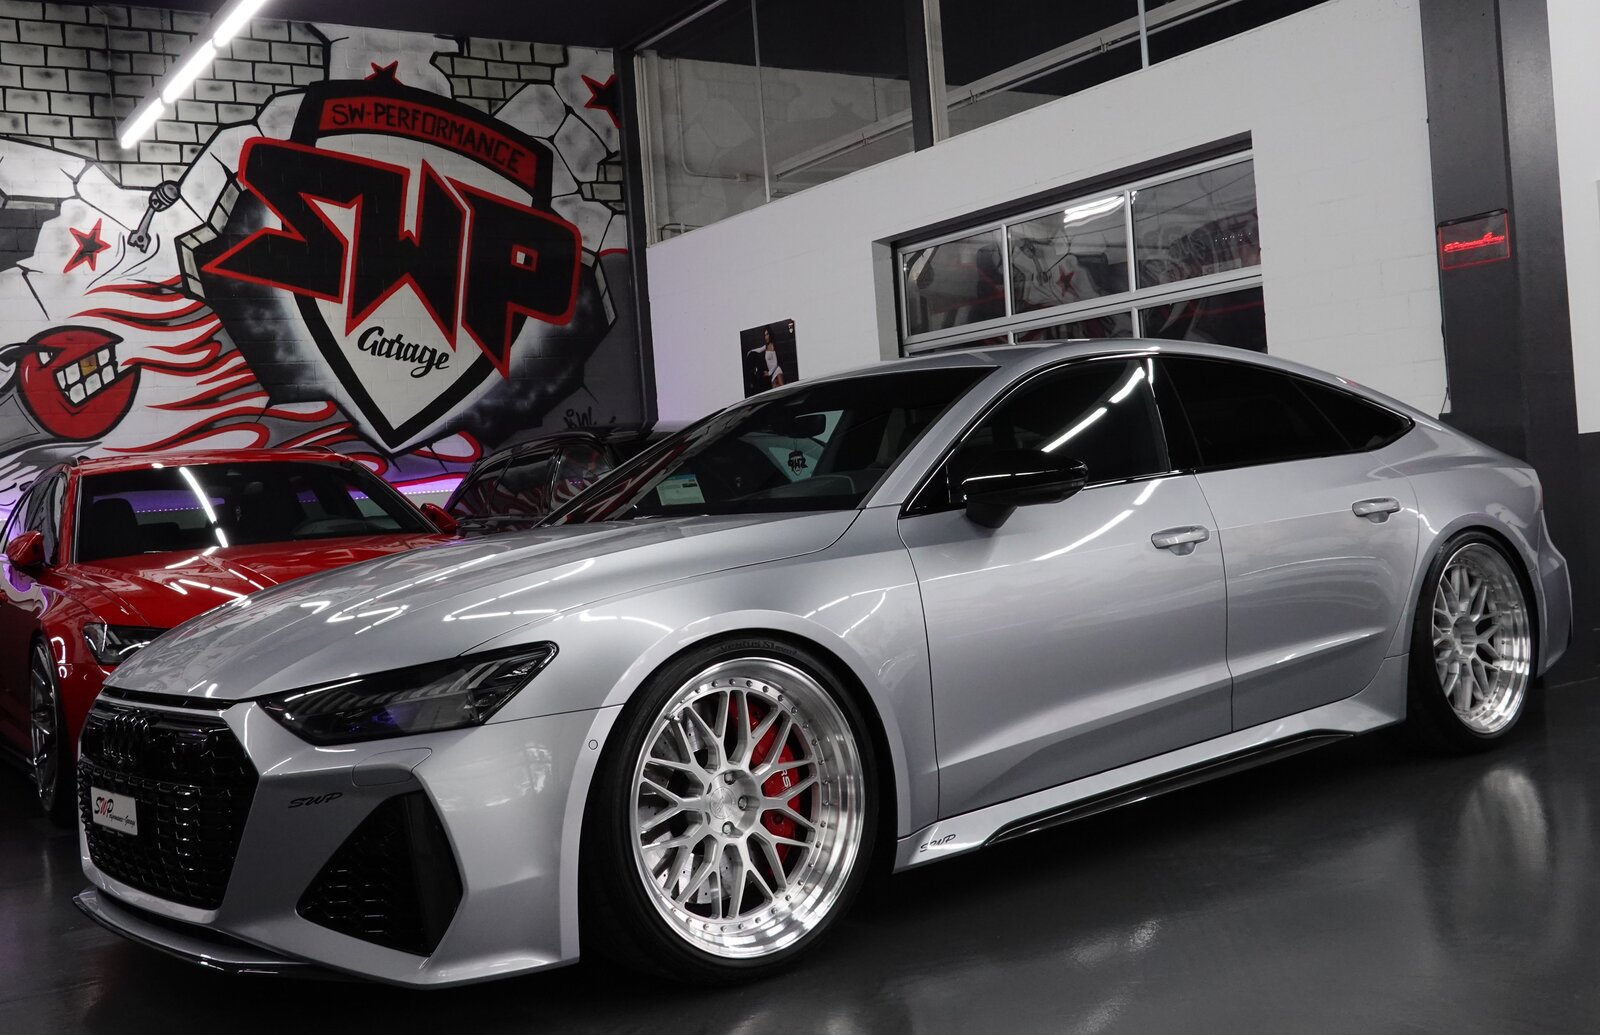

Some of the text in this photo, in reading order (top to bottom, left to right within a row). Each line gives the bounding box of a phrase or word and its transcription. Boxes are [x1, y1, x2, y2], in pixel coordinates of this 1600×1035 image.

[331, 103, 527, 174] SW-PERFORMANCE
[201, 137, 582, 381] SWP
[357, 326, 451, 378] Garage
[94, 796, 114, 818] SWP
[288, 791, 343, 809] SWP
